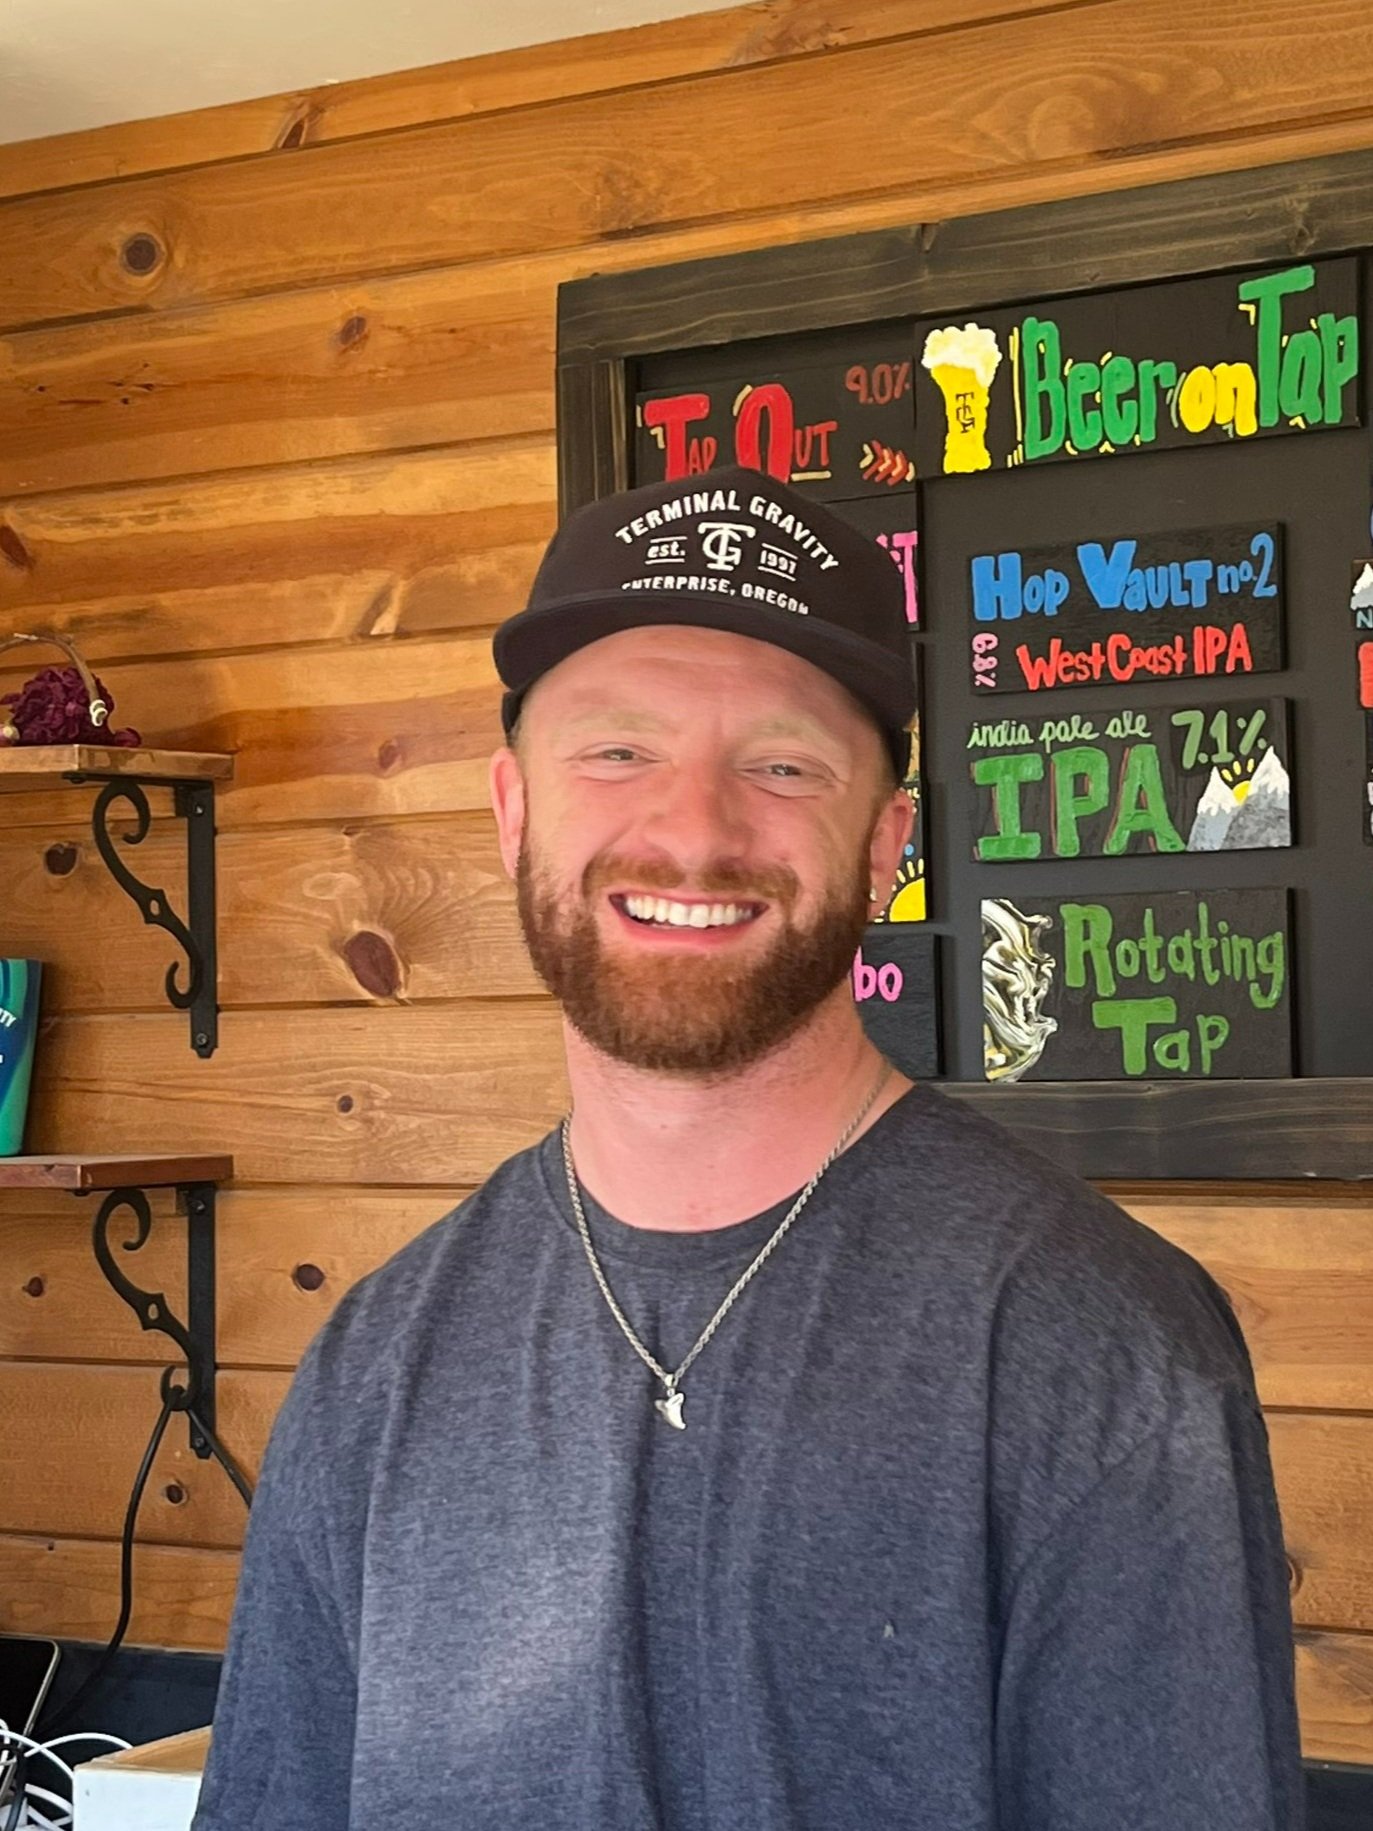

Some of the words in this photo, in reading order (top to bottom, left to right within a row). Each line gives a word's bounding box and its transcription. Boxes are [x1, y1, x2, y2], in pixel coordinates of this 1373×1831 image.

[1022, 316, 1177, 460] Beer
[1179, 363, 1257, 437] on
[1239, 265, 1358, 428] Tap
[615, 490, 740, 544] TERMINAL
[750, 496, 839, 571] GRAVITY
[1016, 638, 1105, 690] West
[1106, 633, 1187, 682] Coast
[1193, 622, 1252, 674] IPA
[967, 722, 1034, 749] india
[1039, 715, 1099, 753] pale
[1105, 711, 1152, 739] ale
[1171, 709, 1266, 770] 7.1%
[973, 744, 1187, 860] IPA
[1059, 901, 1286, 1009] Rotating
